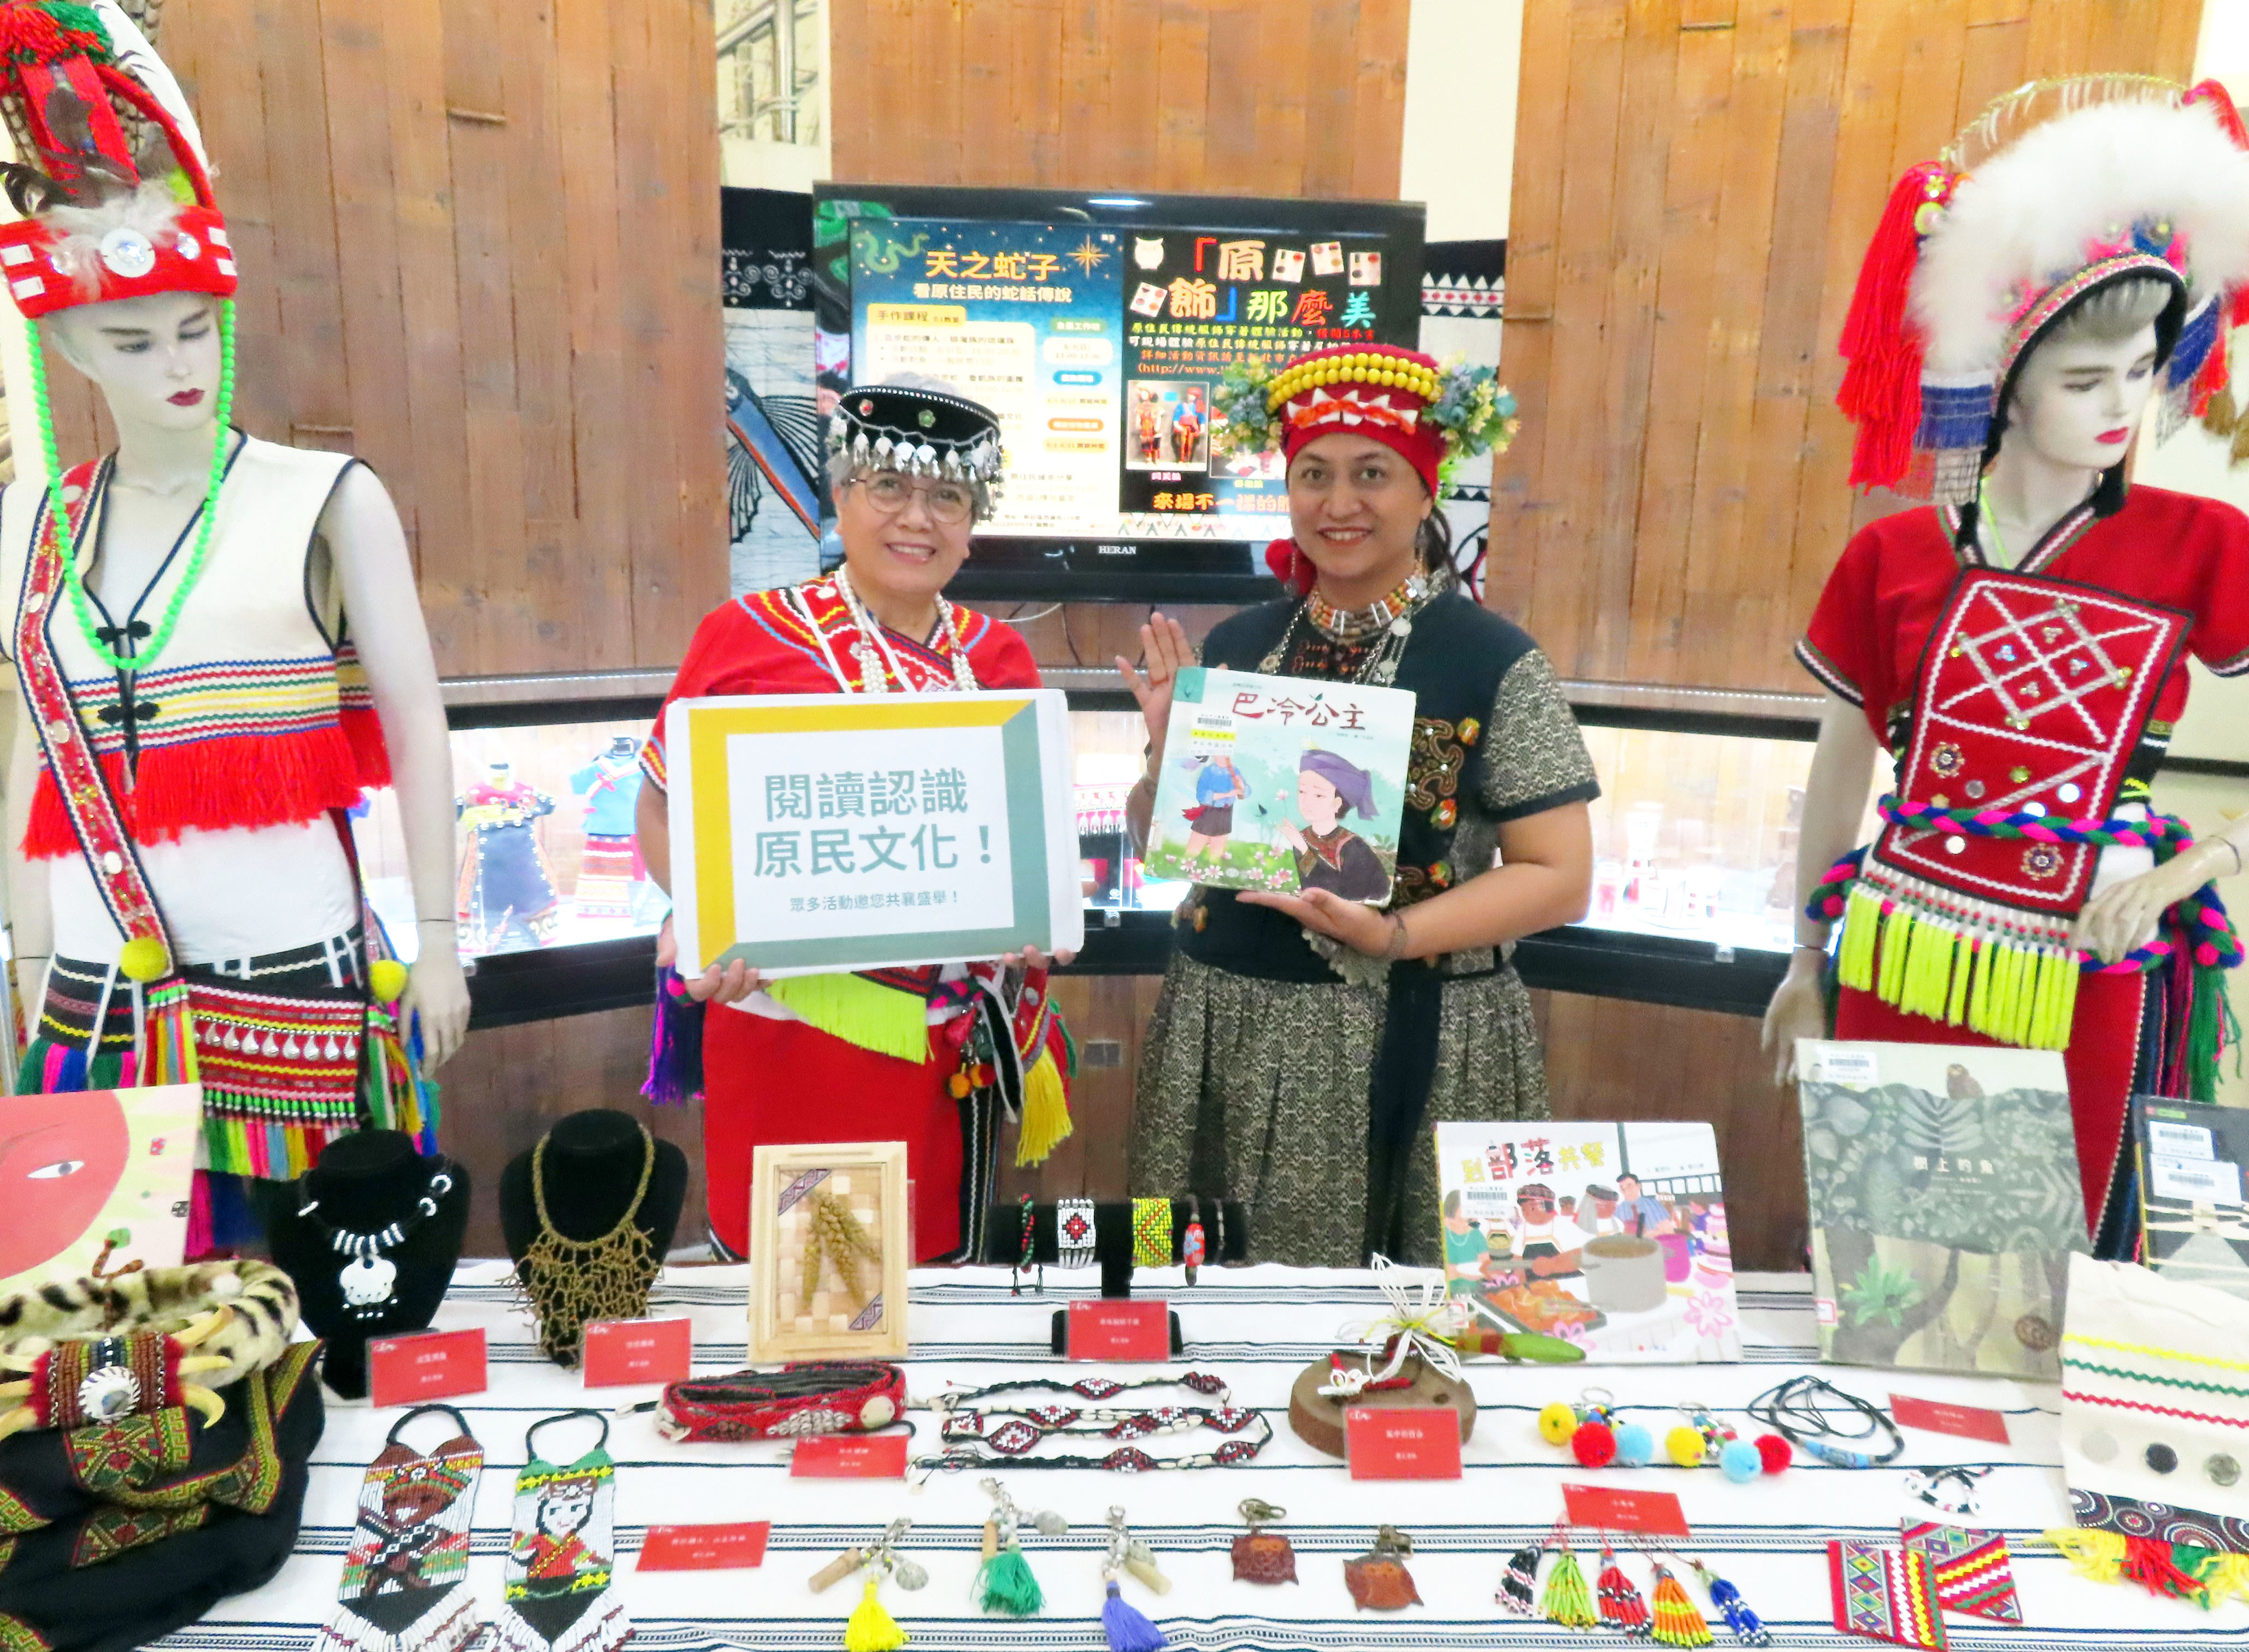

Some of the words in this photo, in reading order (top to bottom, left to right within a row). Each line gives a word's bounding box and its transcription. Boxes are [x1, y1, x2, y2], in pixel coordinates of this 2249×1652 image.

[926, 250, 1060, 281] 天之蛇子
[1194, 237, 1267, 282] 「原
[1098, 545, 1137, 554] HERAN
[1232, 692, 1365, 730] 巴冷公主
[764, 767, 968, 822] 閱讀認識
[753, 823, 992, 877] 原民文化！
[790, 889, 959, 913] 眾多活動邀您共襄盛舉！
